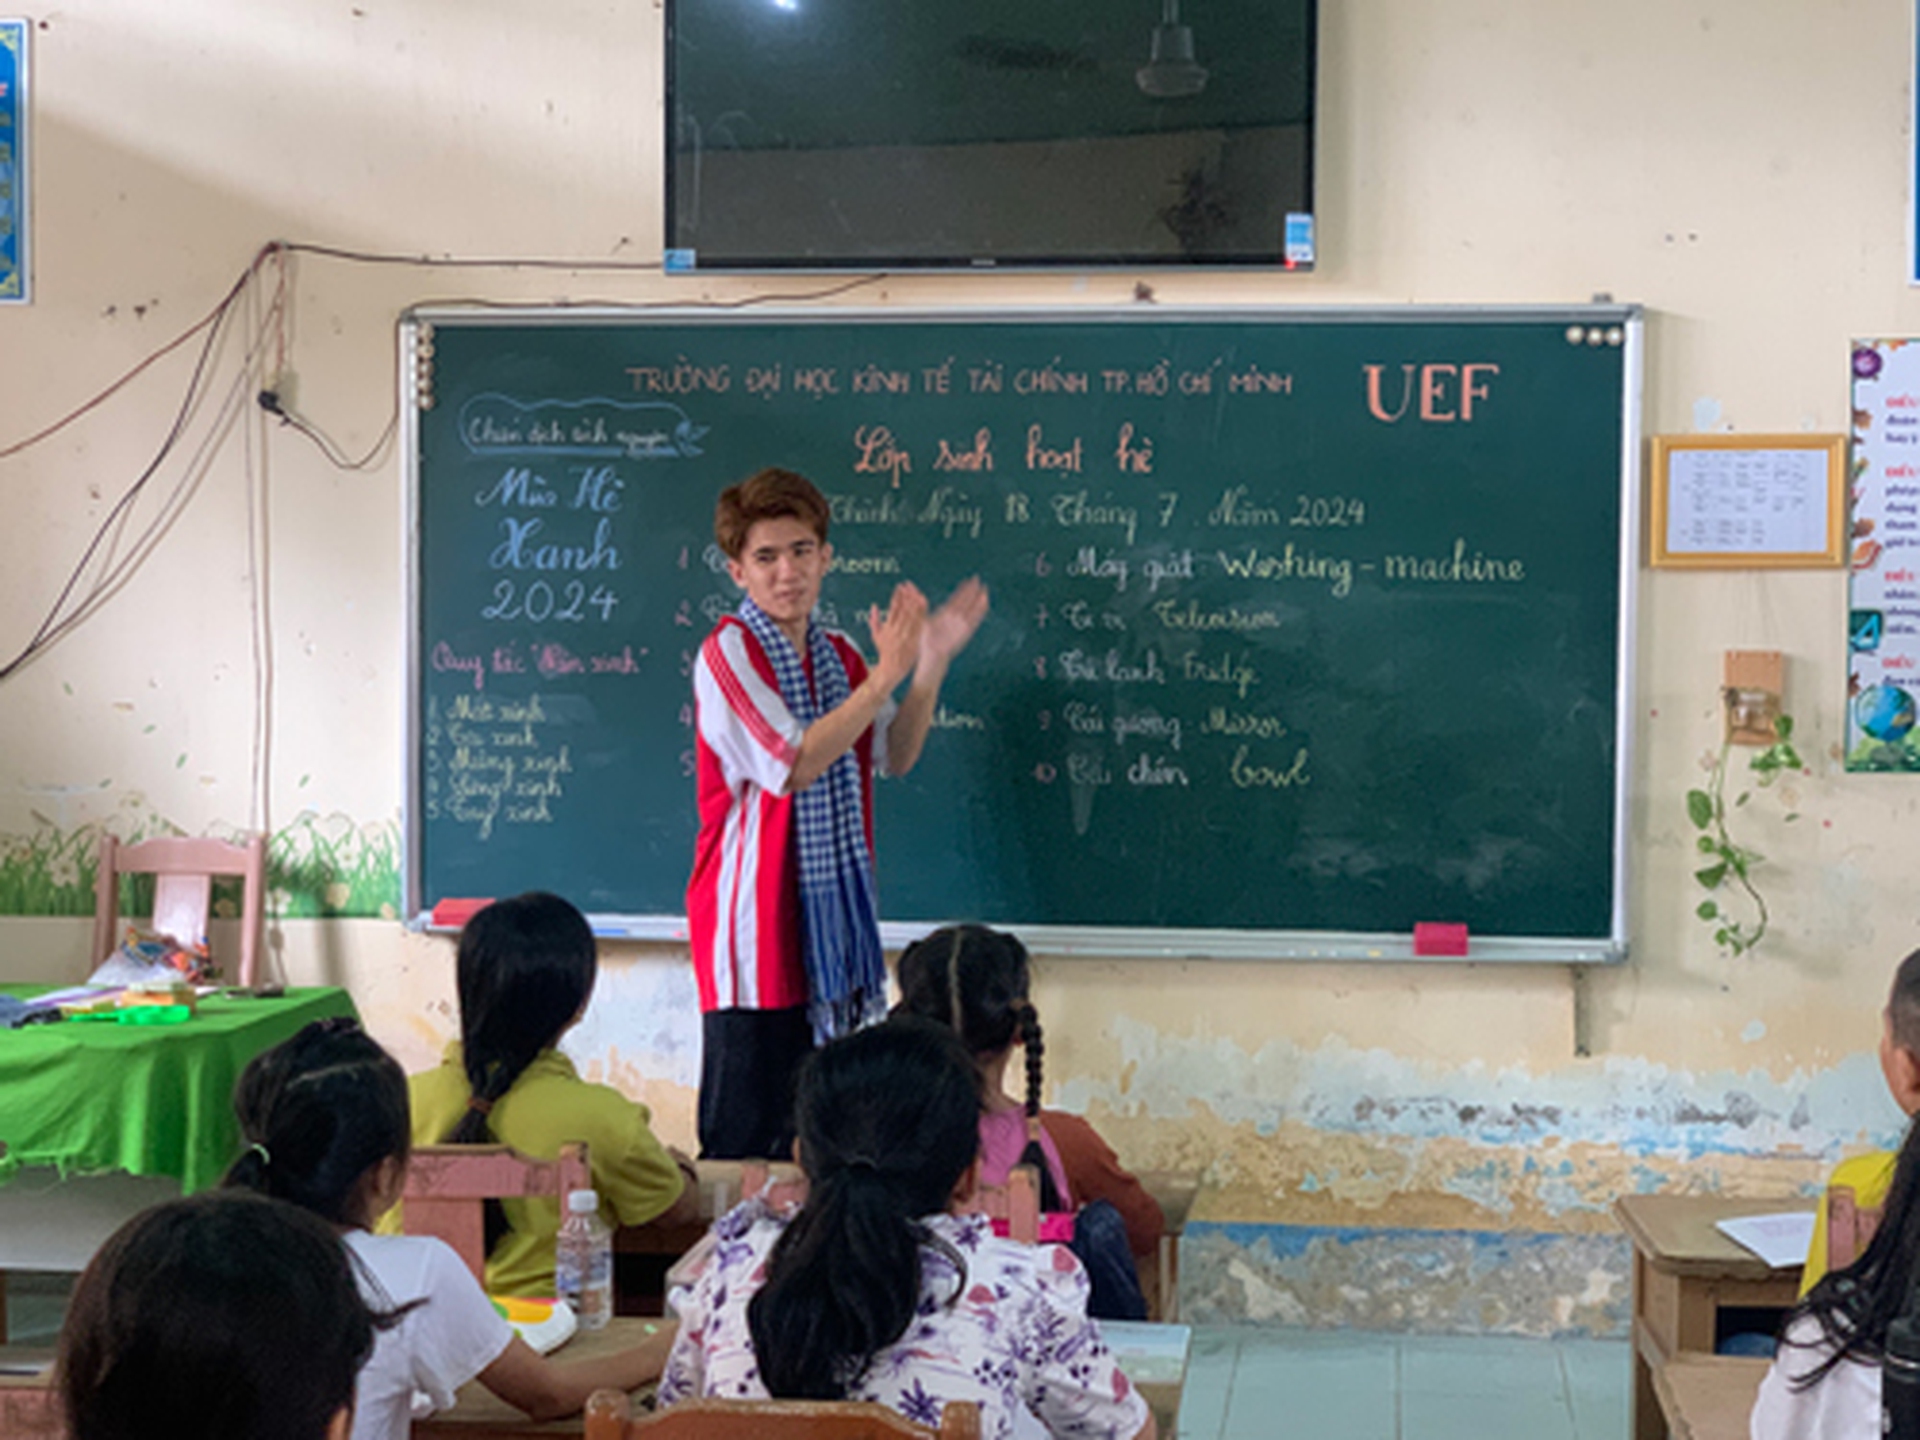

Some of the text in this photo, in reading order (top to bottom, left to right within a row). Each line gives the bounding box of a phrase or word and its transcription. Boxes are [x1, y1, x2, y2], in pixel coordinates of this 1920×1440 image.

[625, 355, 731, 394] TRƯỜNG
[745, 363, 782, 400] ĐẠI
[793, 368, 839, 400] HỌC
[921, 357, 955, 393] TẾ
[968, 359, 1004, 393] TÀI
[1013, 356, 1089, 395] CHÍNH
[1177, 357, 1222, 394] CHÍ
[1229, 364, 1294, 395] MINH
[1363, 362, 1500, 423] UEF
[854, 425, 912, 489] Lớp
[933, 427, 993, 471] sinh
[1114, 422, 1153, 473] hè
[474, 467, 558, 507] Mùa
[1290, 495, 1365, 527] 2024
[488, 516, 622, 570] Xanh
[1218, 543, 1353, 596] Washing
[1384, 538, 1526, 581] machine
[481, 578, 619, 622] 2024
